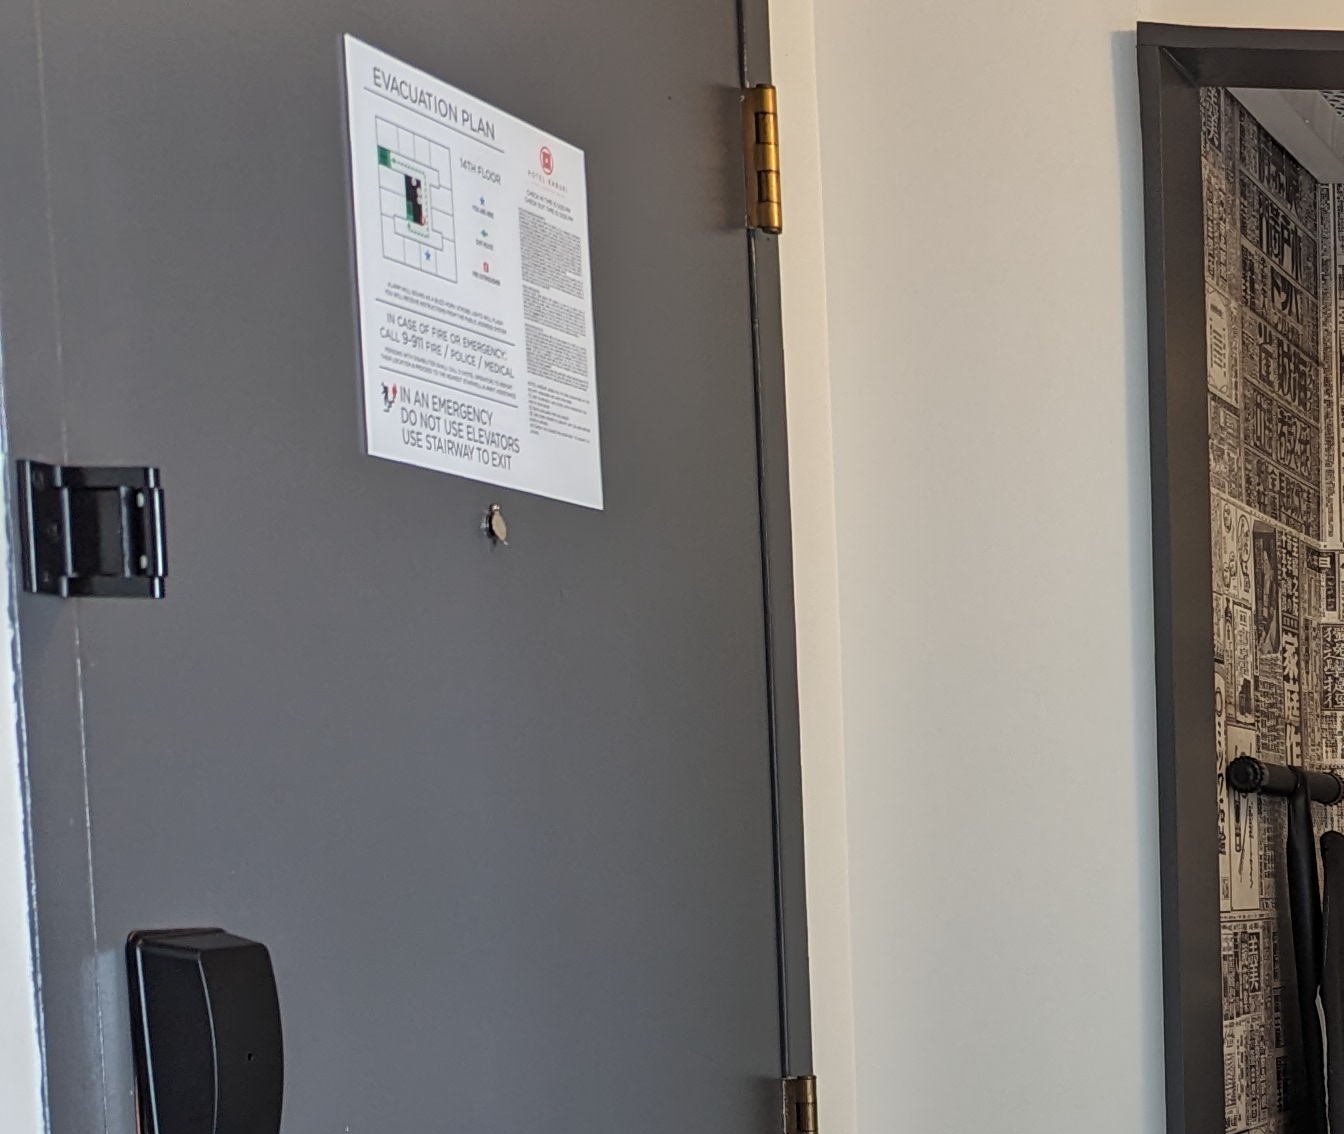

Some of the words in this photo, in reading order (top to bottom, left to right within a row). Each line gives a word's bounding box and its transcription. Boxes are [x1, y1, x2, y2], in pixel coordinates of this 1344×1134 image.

[373, 66, 458, 123] EVACUATION
[461, 109, 495, 141] PLAN
[478, 165, 501, 185] FLOOR
[387, 312, 394, 324] IN
[397, 315, 416, 331] CASE
[419, 322, 429, 335] OF
[432, 326, 447, 341] FIRE
[450, 332, 460, 345] OR
[380, 325, 400, 343] CALL
[402, 331, 423, 350] 9-911
[426, 339, 442, 356] FIRE
[450, 348, 476, 367] POLICE
[484, 358, 514, 379] MEDICAL
[400, 386, 411, 404] IN
[414, 389, 430, 409] AN
[432, 394, 493, 427] EMERGENCY
[401, 407, 418, 427] DO
[420, 412, 441, 432] NOT
[444, 419, 464, 440] USE
[467, 425, 520, 454] ELEVATORS
[402, 427, 423, 449] USE
[426, 434, 475, 460] STAIRWAY
[476, 447, 489, 465] TO
[491, 451, 512, 470] EXIT
